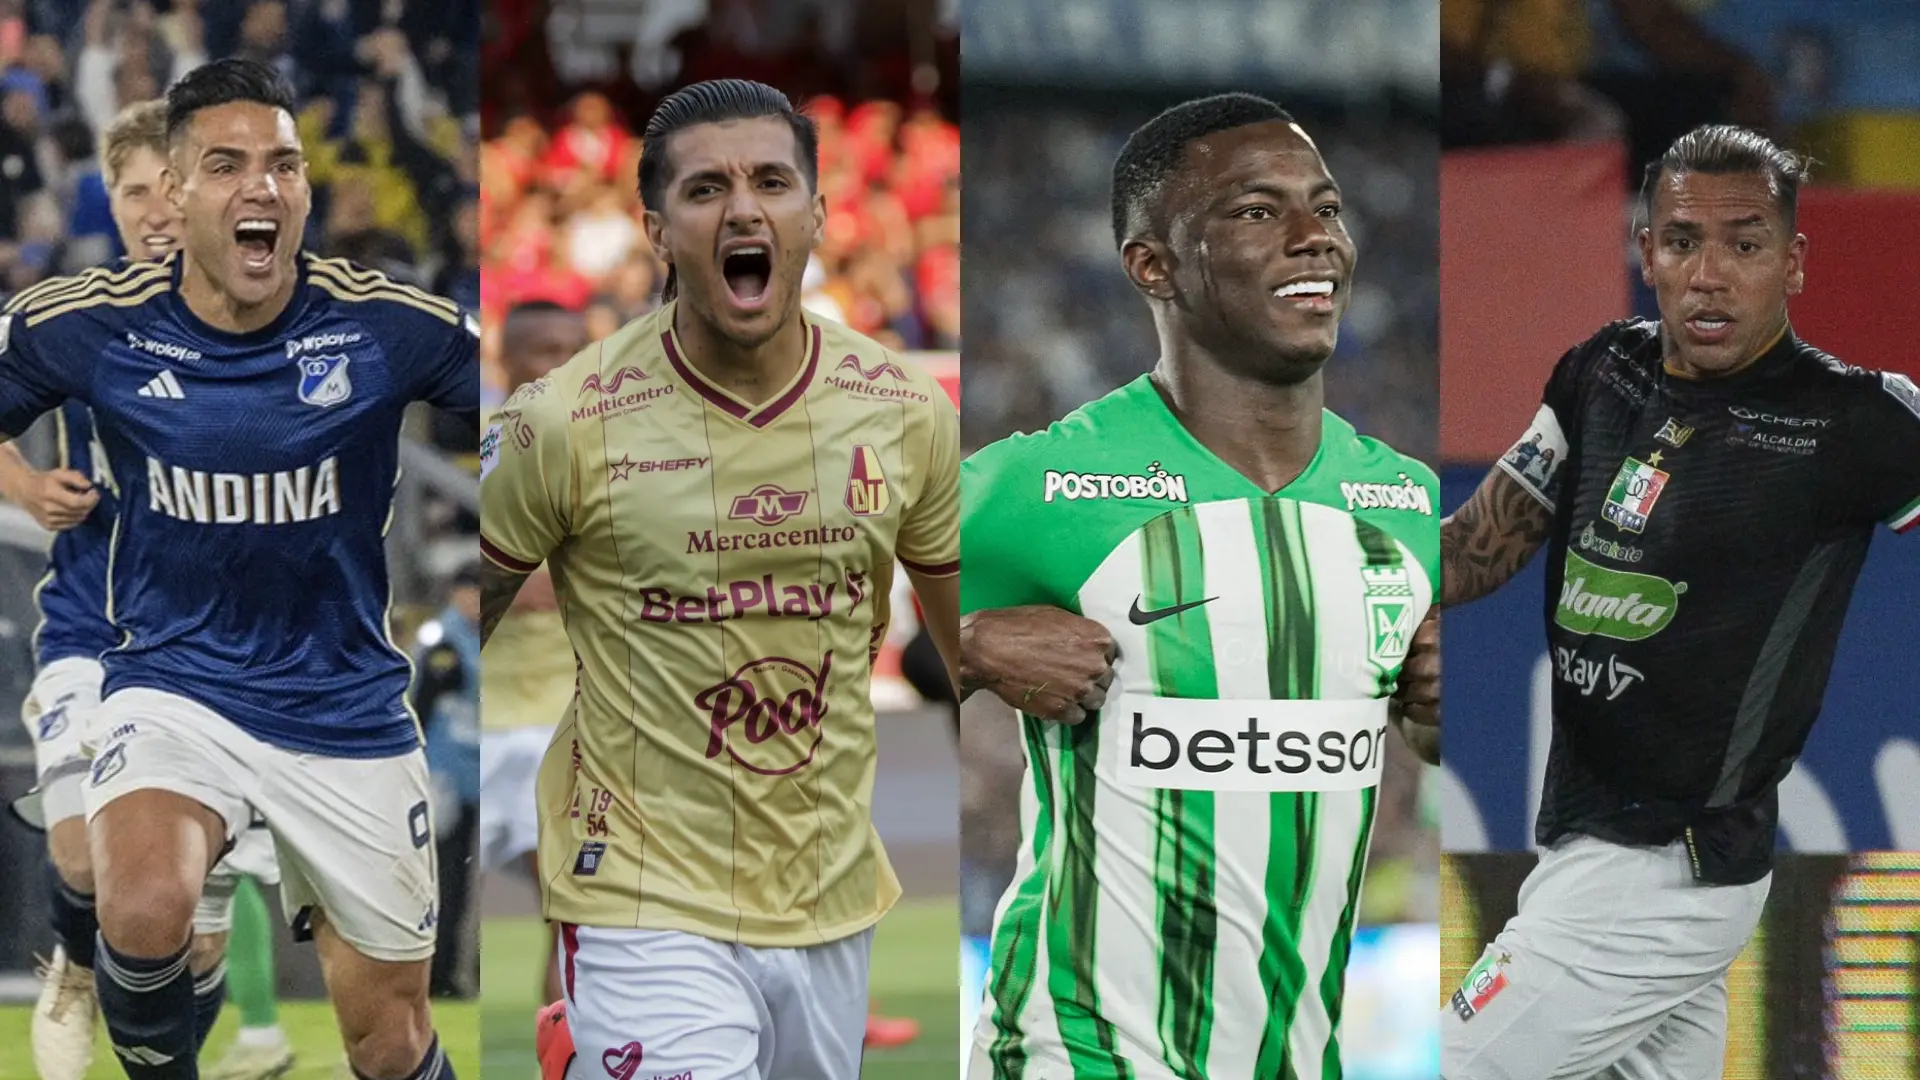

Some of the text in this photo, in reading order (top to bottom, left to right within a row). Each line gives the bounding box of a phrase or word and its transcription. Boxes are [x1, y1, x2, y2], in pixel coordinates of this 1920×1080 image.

[571, 384, 674, 422] Multicentro
[824, 376, 928, 403] Multicentro
[1761, 414, 1831, 427] CHERY
[639, 457, 709, 473] SHEFFY
[146, 456, 342, 524] ANDINA
[686, 525, 855, 554] Mercacentro
[639, 574, 836, 622] BetPlay
[694, 649, 833, 759] Pool
[590, 788, 613, 812] 19
[586, 813, 608, 838] 54
